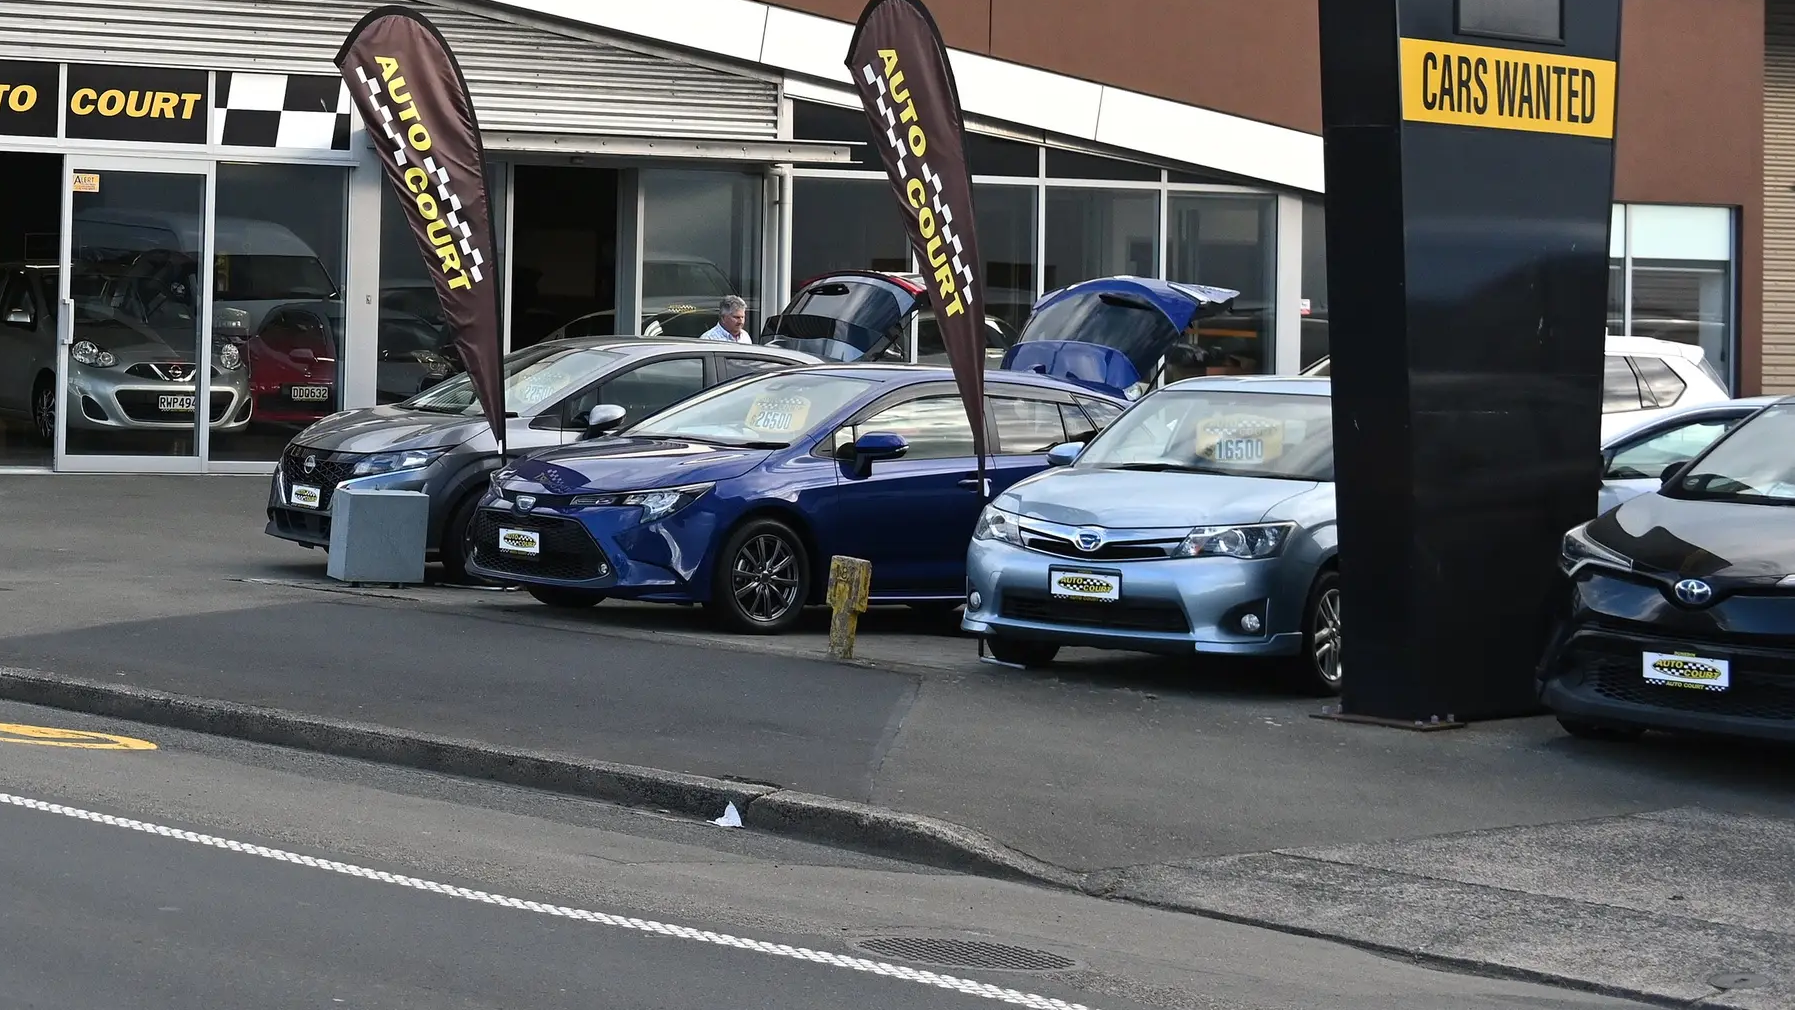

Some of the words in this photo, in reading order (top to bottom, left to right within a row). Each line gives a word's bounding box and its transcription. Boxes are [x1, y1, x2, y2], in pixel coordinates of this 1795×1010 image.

[1422, 52, 1488, 115] CARS
[1495, 59, 1596, 124] WANTED
[70, 88, 202, 119] COURT
[374, 56, 433, 152] AUTO
[404, 167, 472, 291] COURT
[877, 48, 927, 158] AUTO
[906, 177, 964, 317] COURT
[1060, 576, 1083, 584] AUTO
[1083, 584, 1111, 592] COURT
[1656, 659, 1683, 668] AUTO
[1684, 669, 1720, 679] COURT
[1683, 682, 1705, 690] COURT
